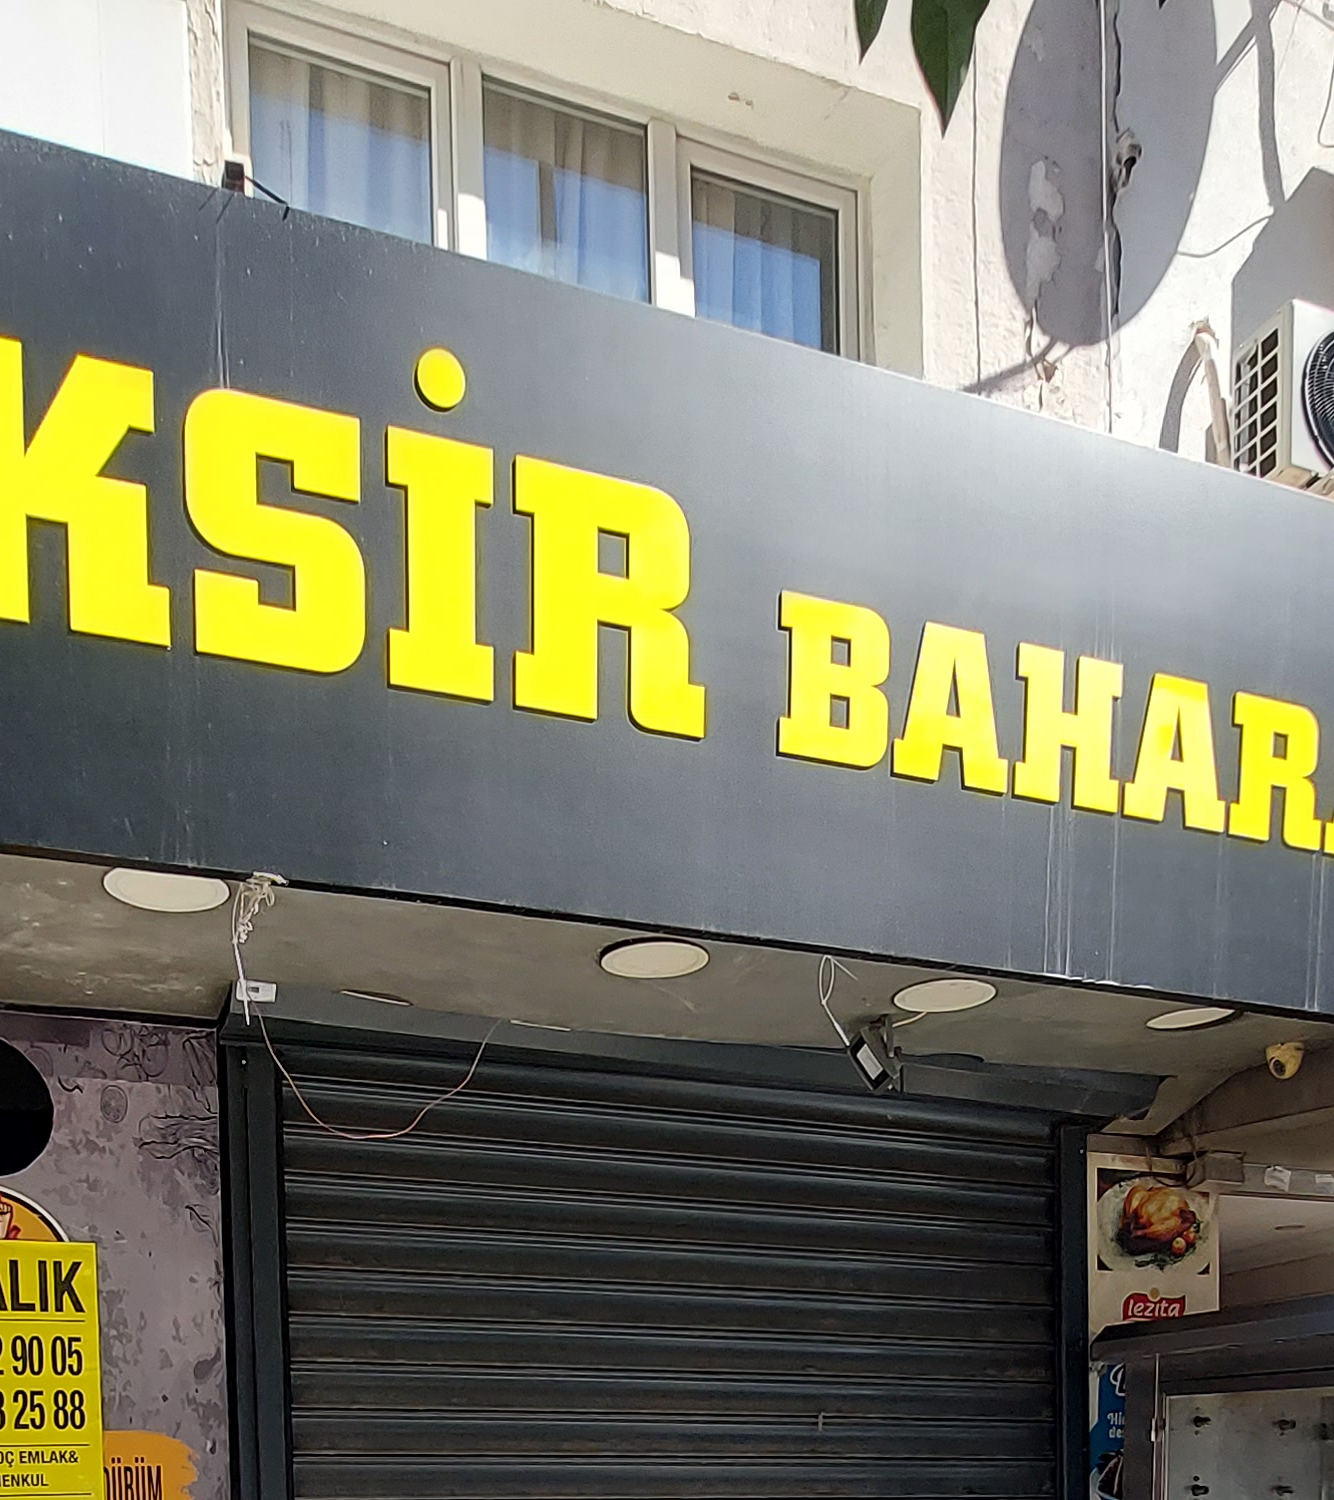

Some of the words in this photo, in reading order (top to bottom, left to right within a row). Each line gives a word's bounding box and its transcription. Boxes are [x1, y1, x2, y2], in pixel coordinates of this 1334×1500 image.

[1127, 1298, 1181, 1318] lezita
[11, 1335, 44, 1376] 90
[51, 1335, 83, 1377] 05
[13, 1389, 46, 1430] 25
[53, 1389, 86, 1430] 88
[19, 1450, 79, 1464] EMLAK&
